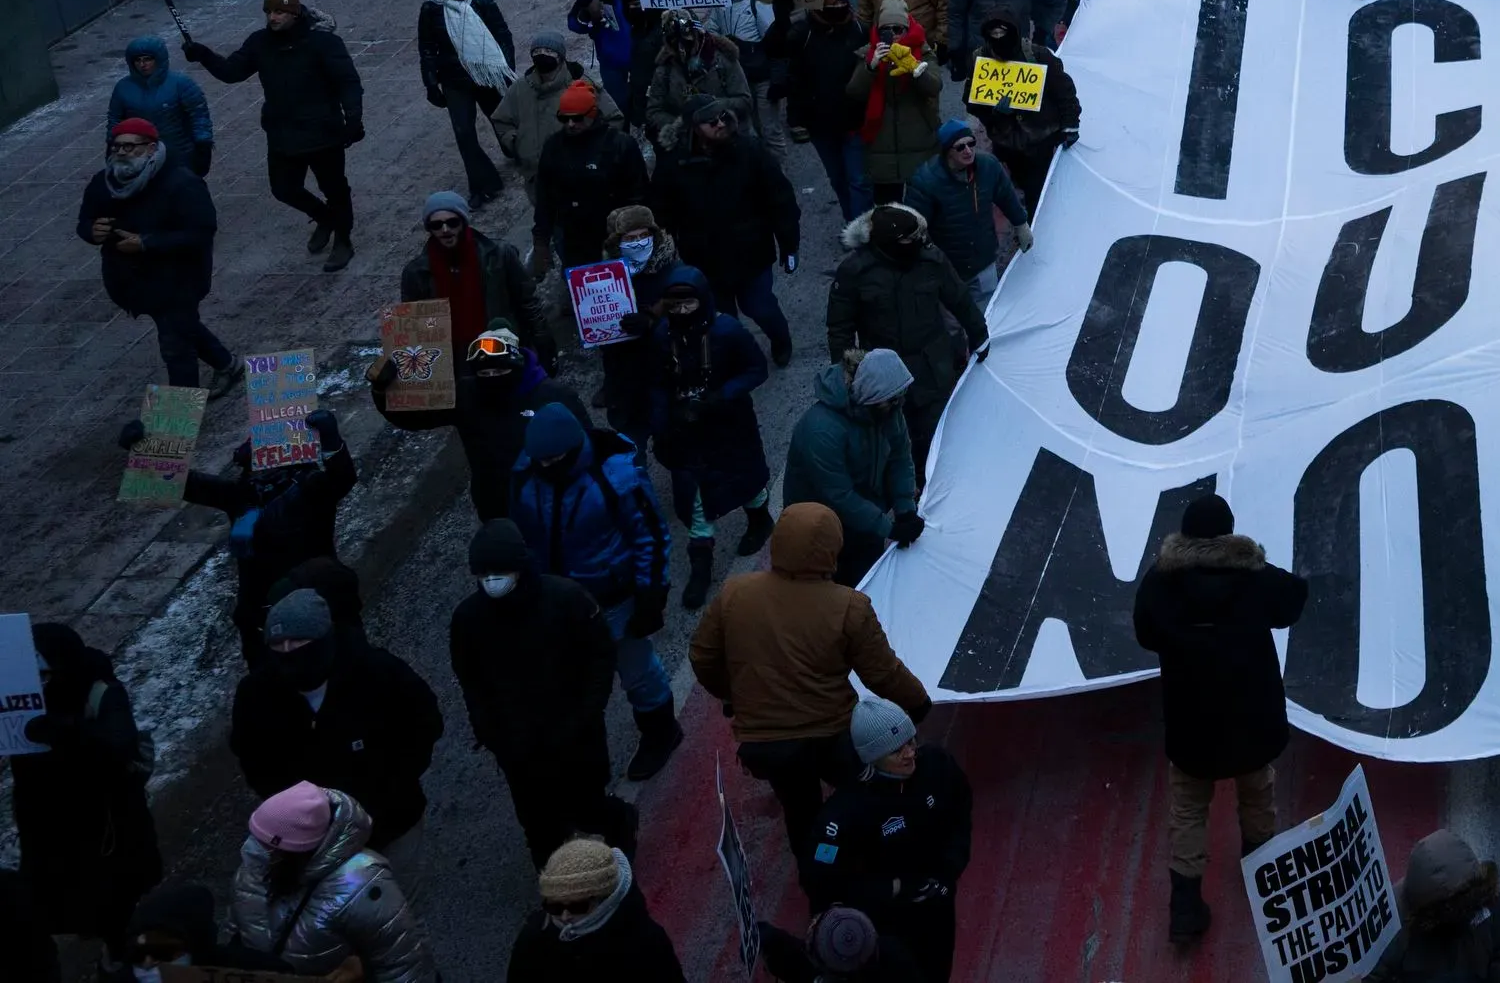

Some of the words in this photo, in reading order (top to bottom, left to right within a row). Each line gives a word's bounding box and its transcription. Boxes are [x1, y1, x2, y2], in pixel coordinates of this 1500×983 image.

[978, 62, 1011, 80] SAY
[975, 84, 1038, 105] FASCISM
[589, 304, 608, 316] OUT
[608, 302, 620, 312] OF
[245, 355, 278, 374] YOU
[259, 405, 313, 422] ILLEGAL
[133, 438, 187, 455] SMALL
[254, 442, 318, 467] FELON
[1254, 792, 1368, 899] GENERAL
[1261, 829, 1377, 934] STRIKE:
[1271, 920, 1318, 967] THE
[1321, 889, 1367, 945] PATH
[1363, 858, 1384, 909] TO
[1288, 894, 1393, 983] JUSTICE
